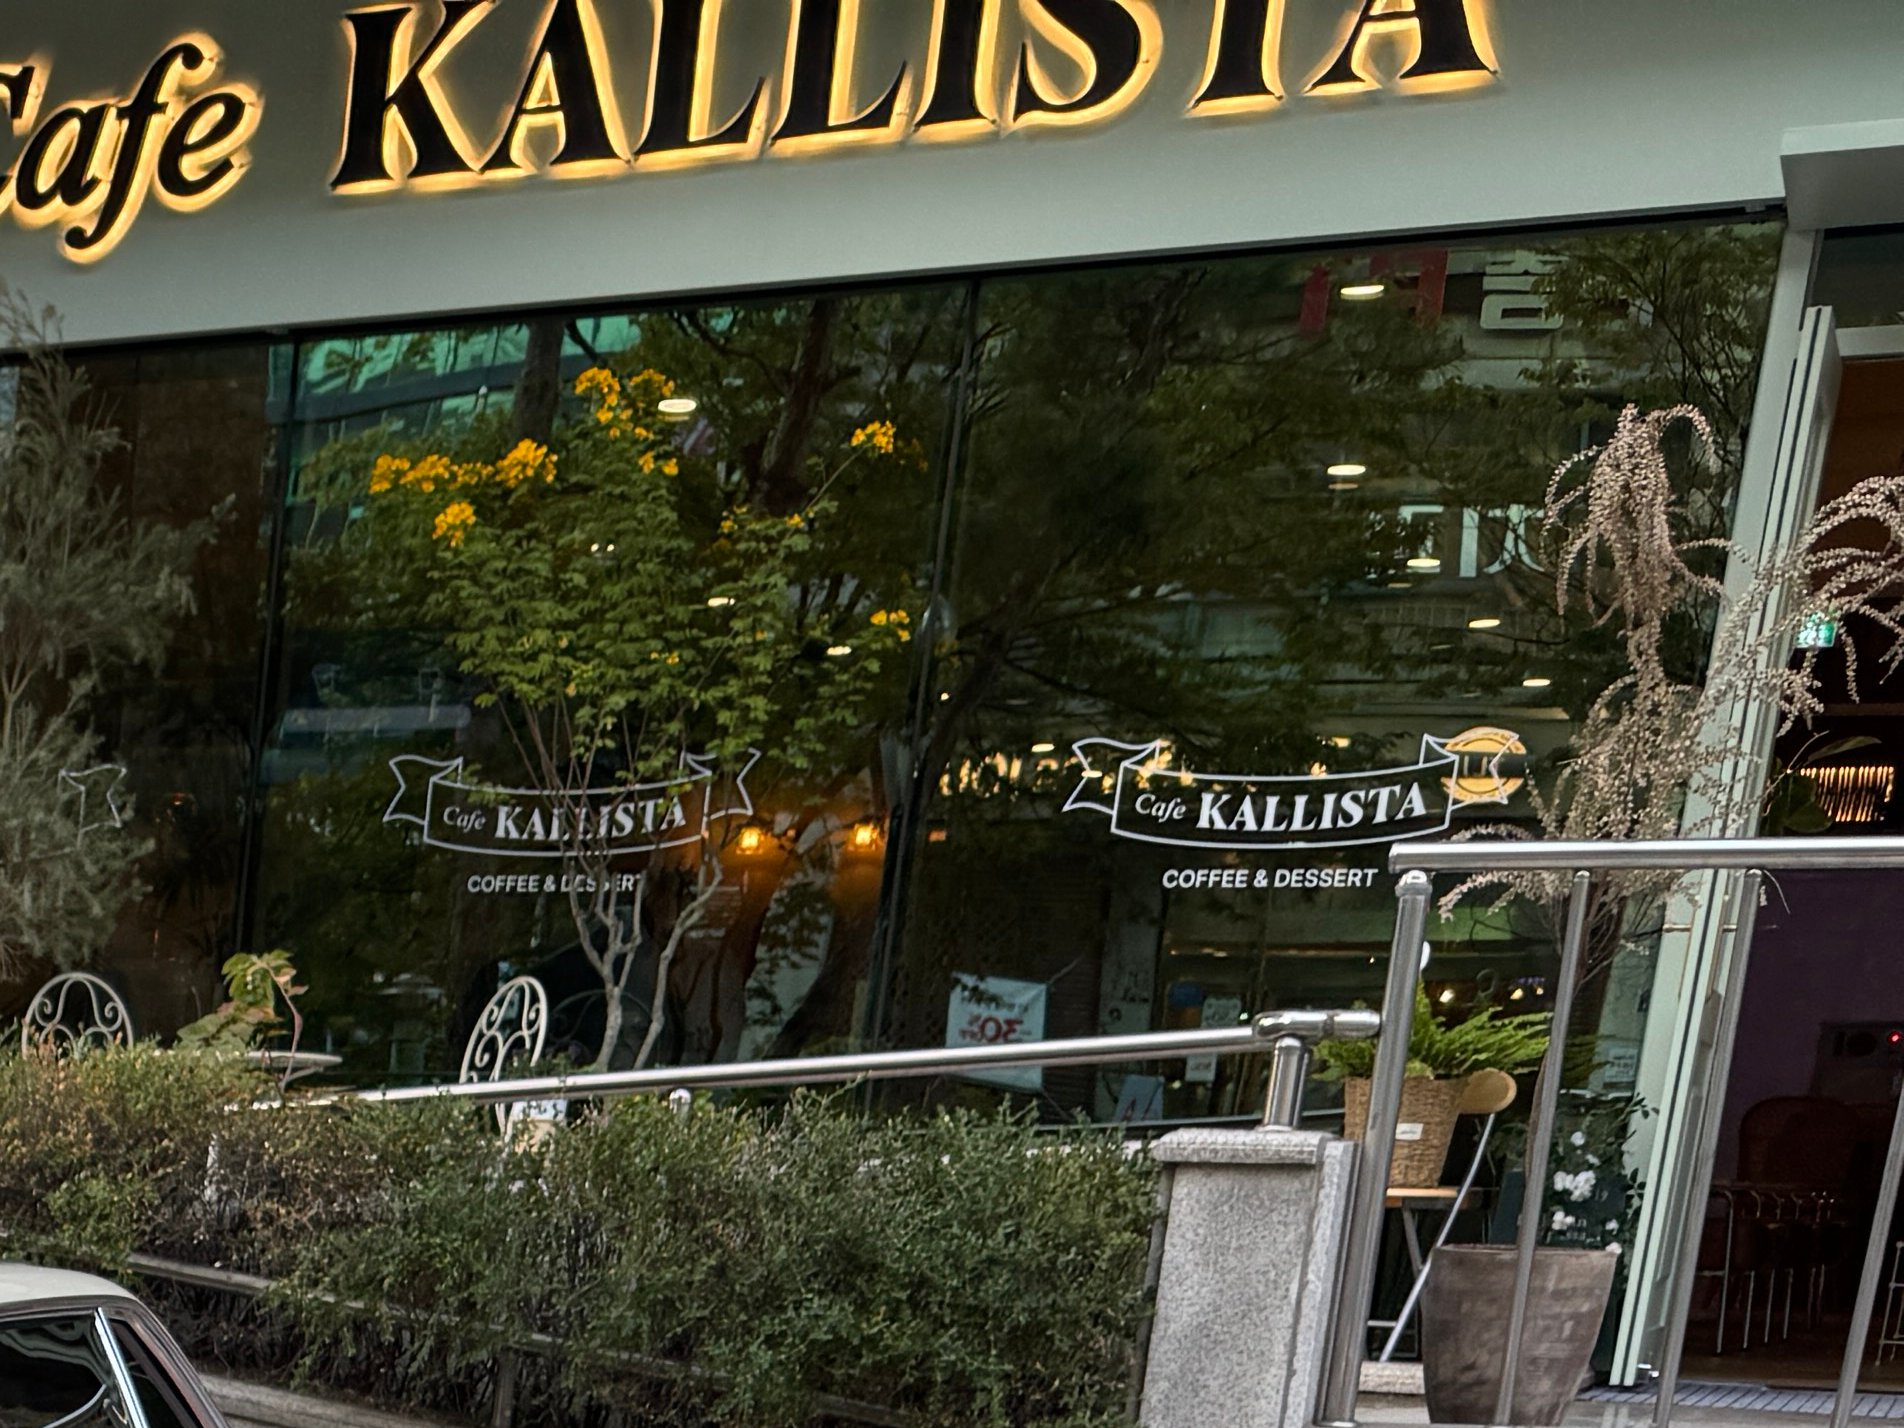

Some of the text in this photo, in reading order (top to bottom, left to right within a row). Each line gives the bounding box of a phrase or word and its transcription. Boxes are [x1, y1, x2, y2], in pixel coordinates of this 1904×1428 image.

[443, 805, 486, 832] Cafe
[1135, 781, 1428, 832] Cafe KALLISTA
[467, 873, 643, 893] COFFEE & DESERT
[1162, 867, 1379, 889] COFFEE & DESSERT
